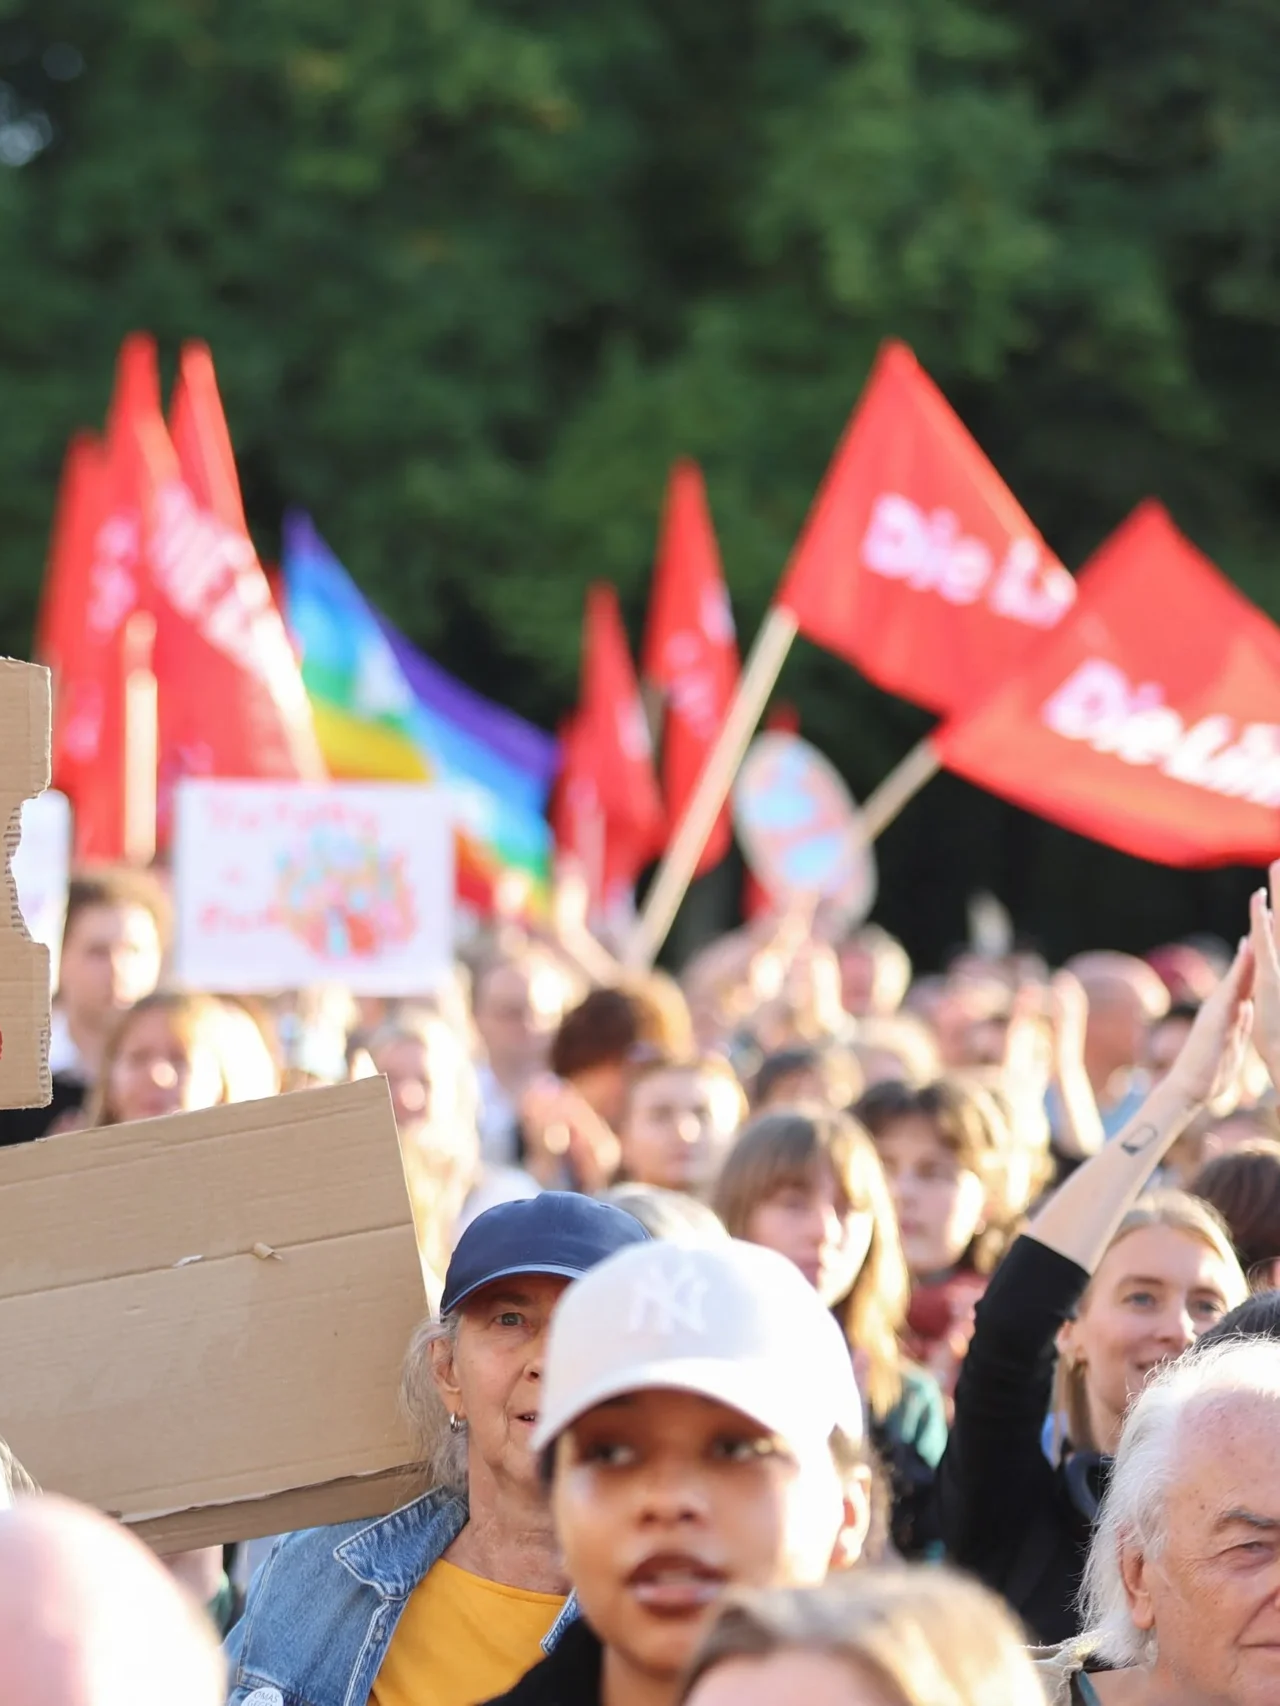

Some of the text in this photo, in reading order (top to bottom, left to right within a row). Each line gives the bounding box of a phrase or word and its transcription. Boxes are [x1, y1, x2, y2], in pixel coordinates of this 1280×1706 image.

[861, 492, 993, 606] Die
[1041, 655, 1183, 766] Die
[628, 1257, 711, 1337] NY
